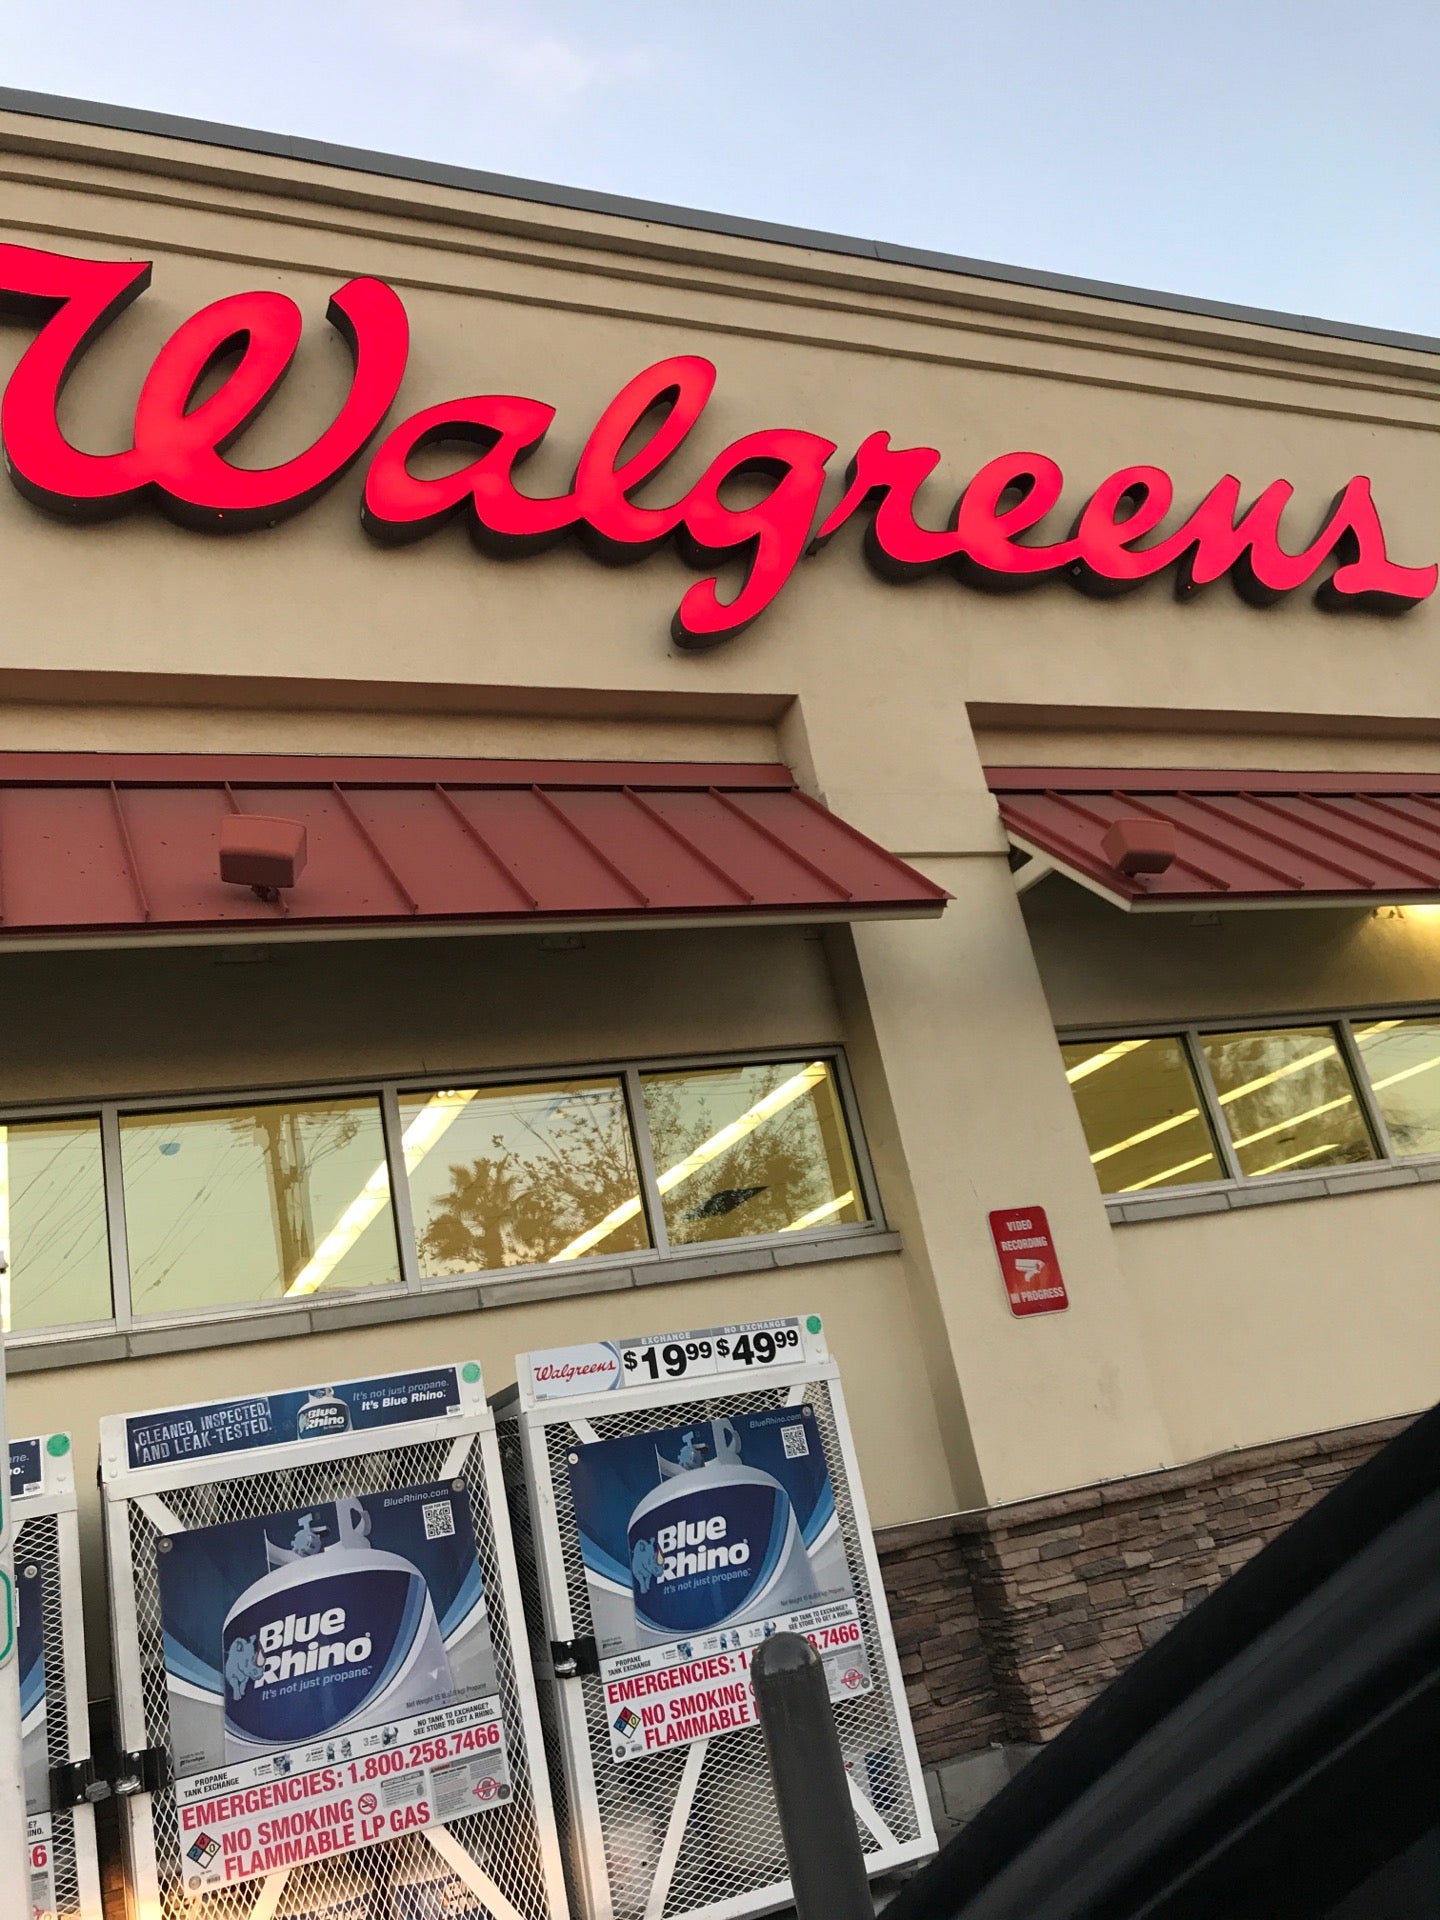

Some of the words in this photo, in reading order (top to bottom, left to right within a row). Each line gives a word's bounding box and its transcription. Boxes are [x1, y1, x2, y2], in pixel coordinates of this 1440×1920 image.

[0, 242, 1438, 640] Walgreens
[1006, 1219, 1033, 1232] VIDEO
[1001, 1236, 1048, 1251] RECORDING
[1010, 1293, 1021, 1304] IN
[1021, 1286, 1065, 1302] PROGRESS
[641, 1331, 691, 1344] EXCHANGE
[724, 1326, 738, 1334] NO
[739, 1319, 787, 1331] EXCHANGE
[534, 1360, 617, 1383] Walgreens
[352, 1391, 368, 1401] It's
[369, 1389, 386, 1399] not
[387, 1385, 406, 1400] just
[408, 1378, 450, 1393] propane.
[308, 1407, 338, 1418] Blue
[361, 1400, 379, 1412] It's
[382, 1397, 408, 1408] Blue
[138, 1420, 197, 1447] CLEANED,
[200, 1402, 270, 1431] INSPECTED,
[749, 1413, 802, 1429] BlueRhino.com
[143, 1441, 171, 1464] AND
[174, 1417, 272, 1455] LEAK-TESTED.
[383, 1488, 449, 1508] BlueRhino.com
[657, 1515, 727, 1554] Blue
[656, 1541, 750, 1584] Rhino
[663, 1585, 676, 1595] It's
[677, 1580, 692, 1590] not
[692, 1576, 711, 1589] just
[799, 1612, 813, 1621] TANK
[820, 1603, 849, 1616] EXCHANGE?
[799, 1618, 815, 1629] STORE
[259, 1607, 346, 1653] Blue
[253, 1635, 372, 1689] Rhino
[607, 1668, 622, 1677] TANK
[622, 1659, 651, 1673] EXCHANGE
[615, 1655, 641, 1667] PROPANE
[262, 1689, 277, 1701] It's
[279, 1683, 298, 1696] not
[299, 1677, 320, 1692] just
[607, 1655, 736, 1705] EMERGENCIES:
[417, 1719, 427, 1727] NO
[427, 1714, 444, 1725] TANK
[445, 1711, 453, 1719] TO
[454, 1702, 489, 1716] EXCHANGE?
[641, 1703, 666, 1727] NO
[669, 1682, 747, 1720] SMOKING
[413, 1728, 425, 1736] SEE
[427, 1722, 446, 1734] STORE
[447, 1719, 455, 1727] TO
[456, 1715, 468, 1724] GET
[474, 1708, 495, 1719] RHINO.
[644, 1703, 751, 1750] FLAMMABLE
[181, 1769, 345, 1831] EMERGENCIES:
[347, 1723, 501, 1785] 1.800.258.7466
[183, 1788, 204, 1799] TANK
[203, 1777, 240, 1794] EXCHANGE
[194, 1772, 228, 1788] PROPANE
[221, 1827, 252, 1856] NO
[257, 1798, 355, 1846] SMOKING
[223, 1823, 357, 1881] FLAMMABLE
[361, 1814, 386, 1842] LP
[389, 1801, 431, 1833] GAS
